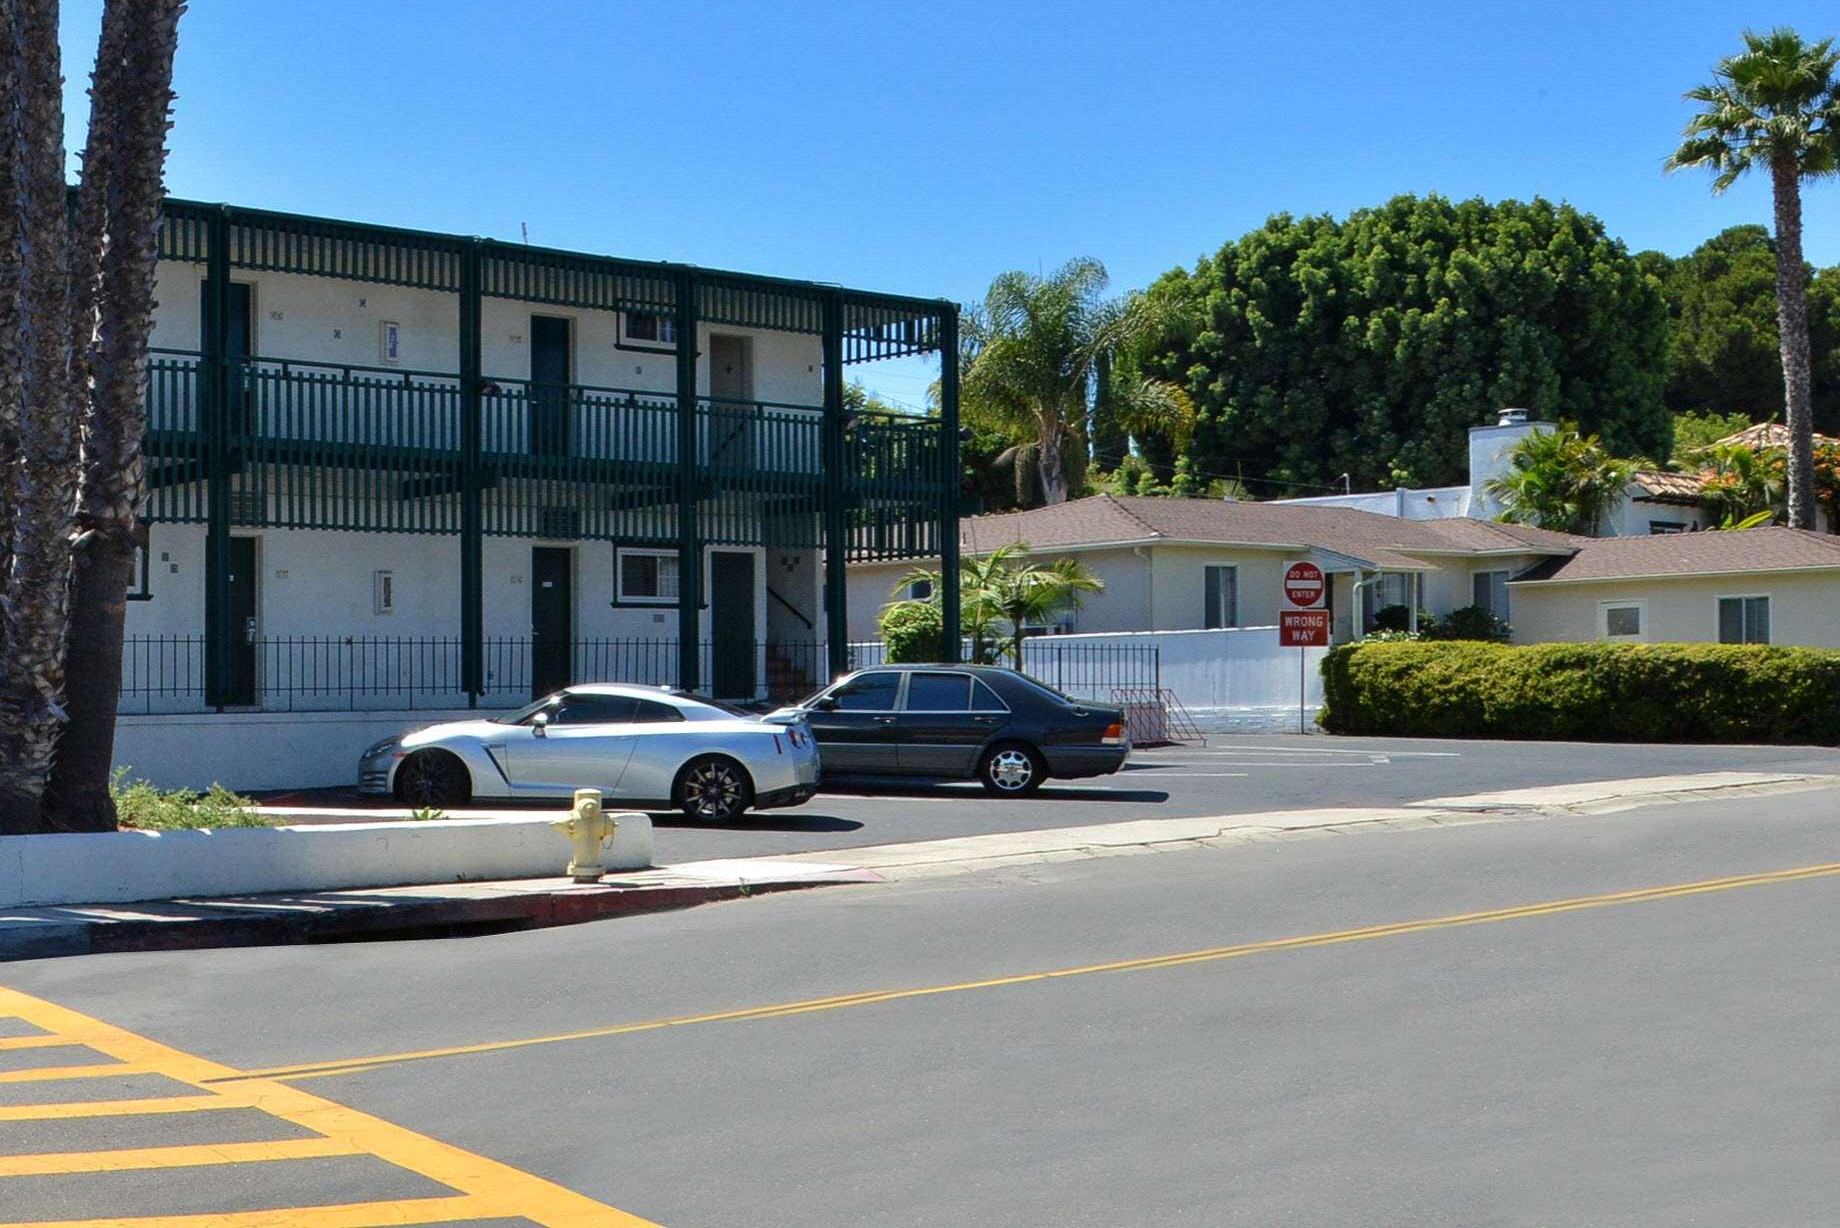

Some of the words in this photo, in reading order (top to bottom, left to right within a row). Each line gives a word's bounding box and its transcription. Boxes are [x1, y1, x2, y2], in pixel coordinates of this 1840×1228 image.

[1289, 571, 1300, 579] DO
[1303, 570, 1318, 578] NOT
[1291, 591, 1316, 599] ENTER
[1285, 616, 1324, 628] WRONG
[1292, 630, 1316, 641] WAY
